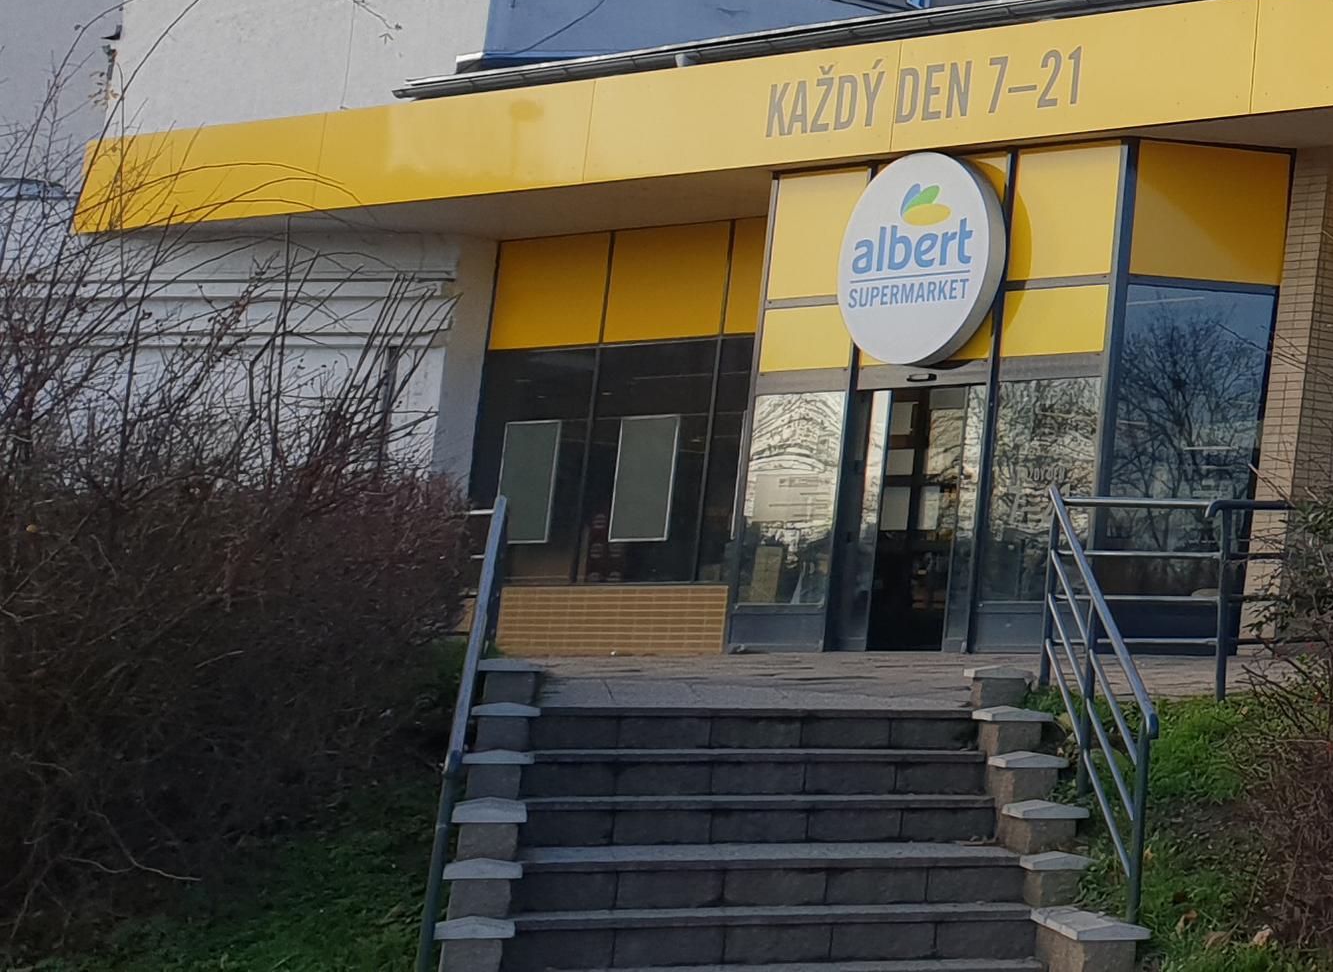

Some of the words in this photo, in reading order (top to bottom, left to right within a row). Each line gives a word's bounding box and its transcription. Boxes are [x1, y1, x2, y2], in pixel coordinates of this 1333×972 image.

[765, 59, 885, 138] KAŽDÝ
[895, 60, 973, 124] DEN
[852, 216, 974, 275] albert
[847, 278, 970, 309] SUPERMARKET
